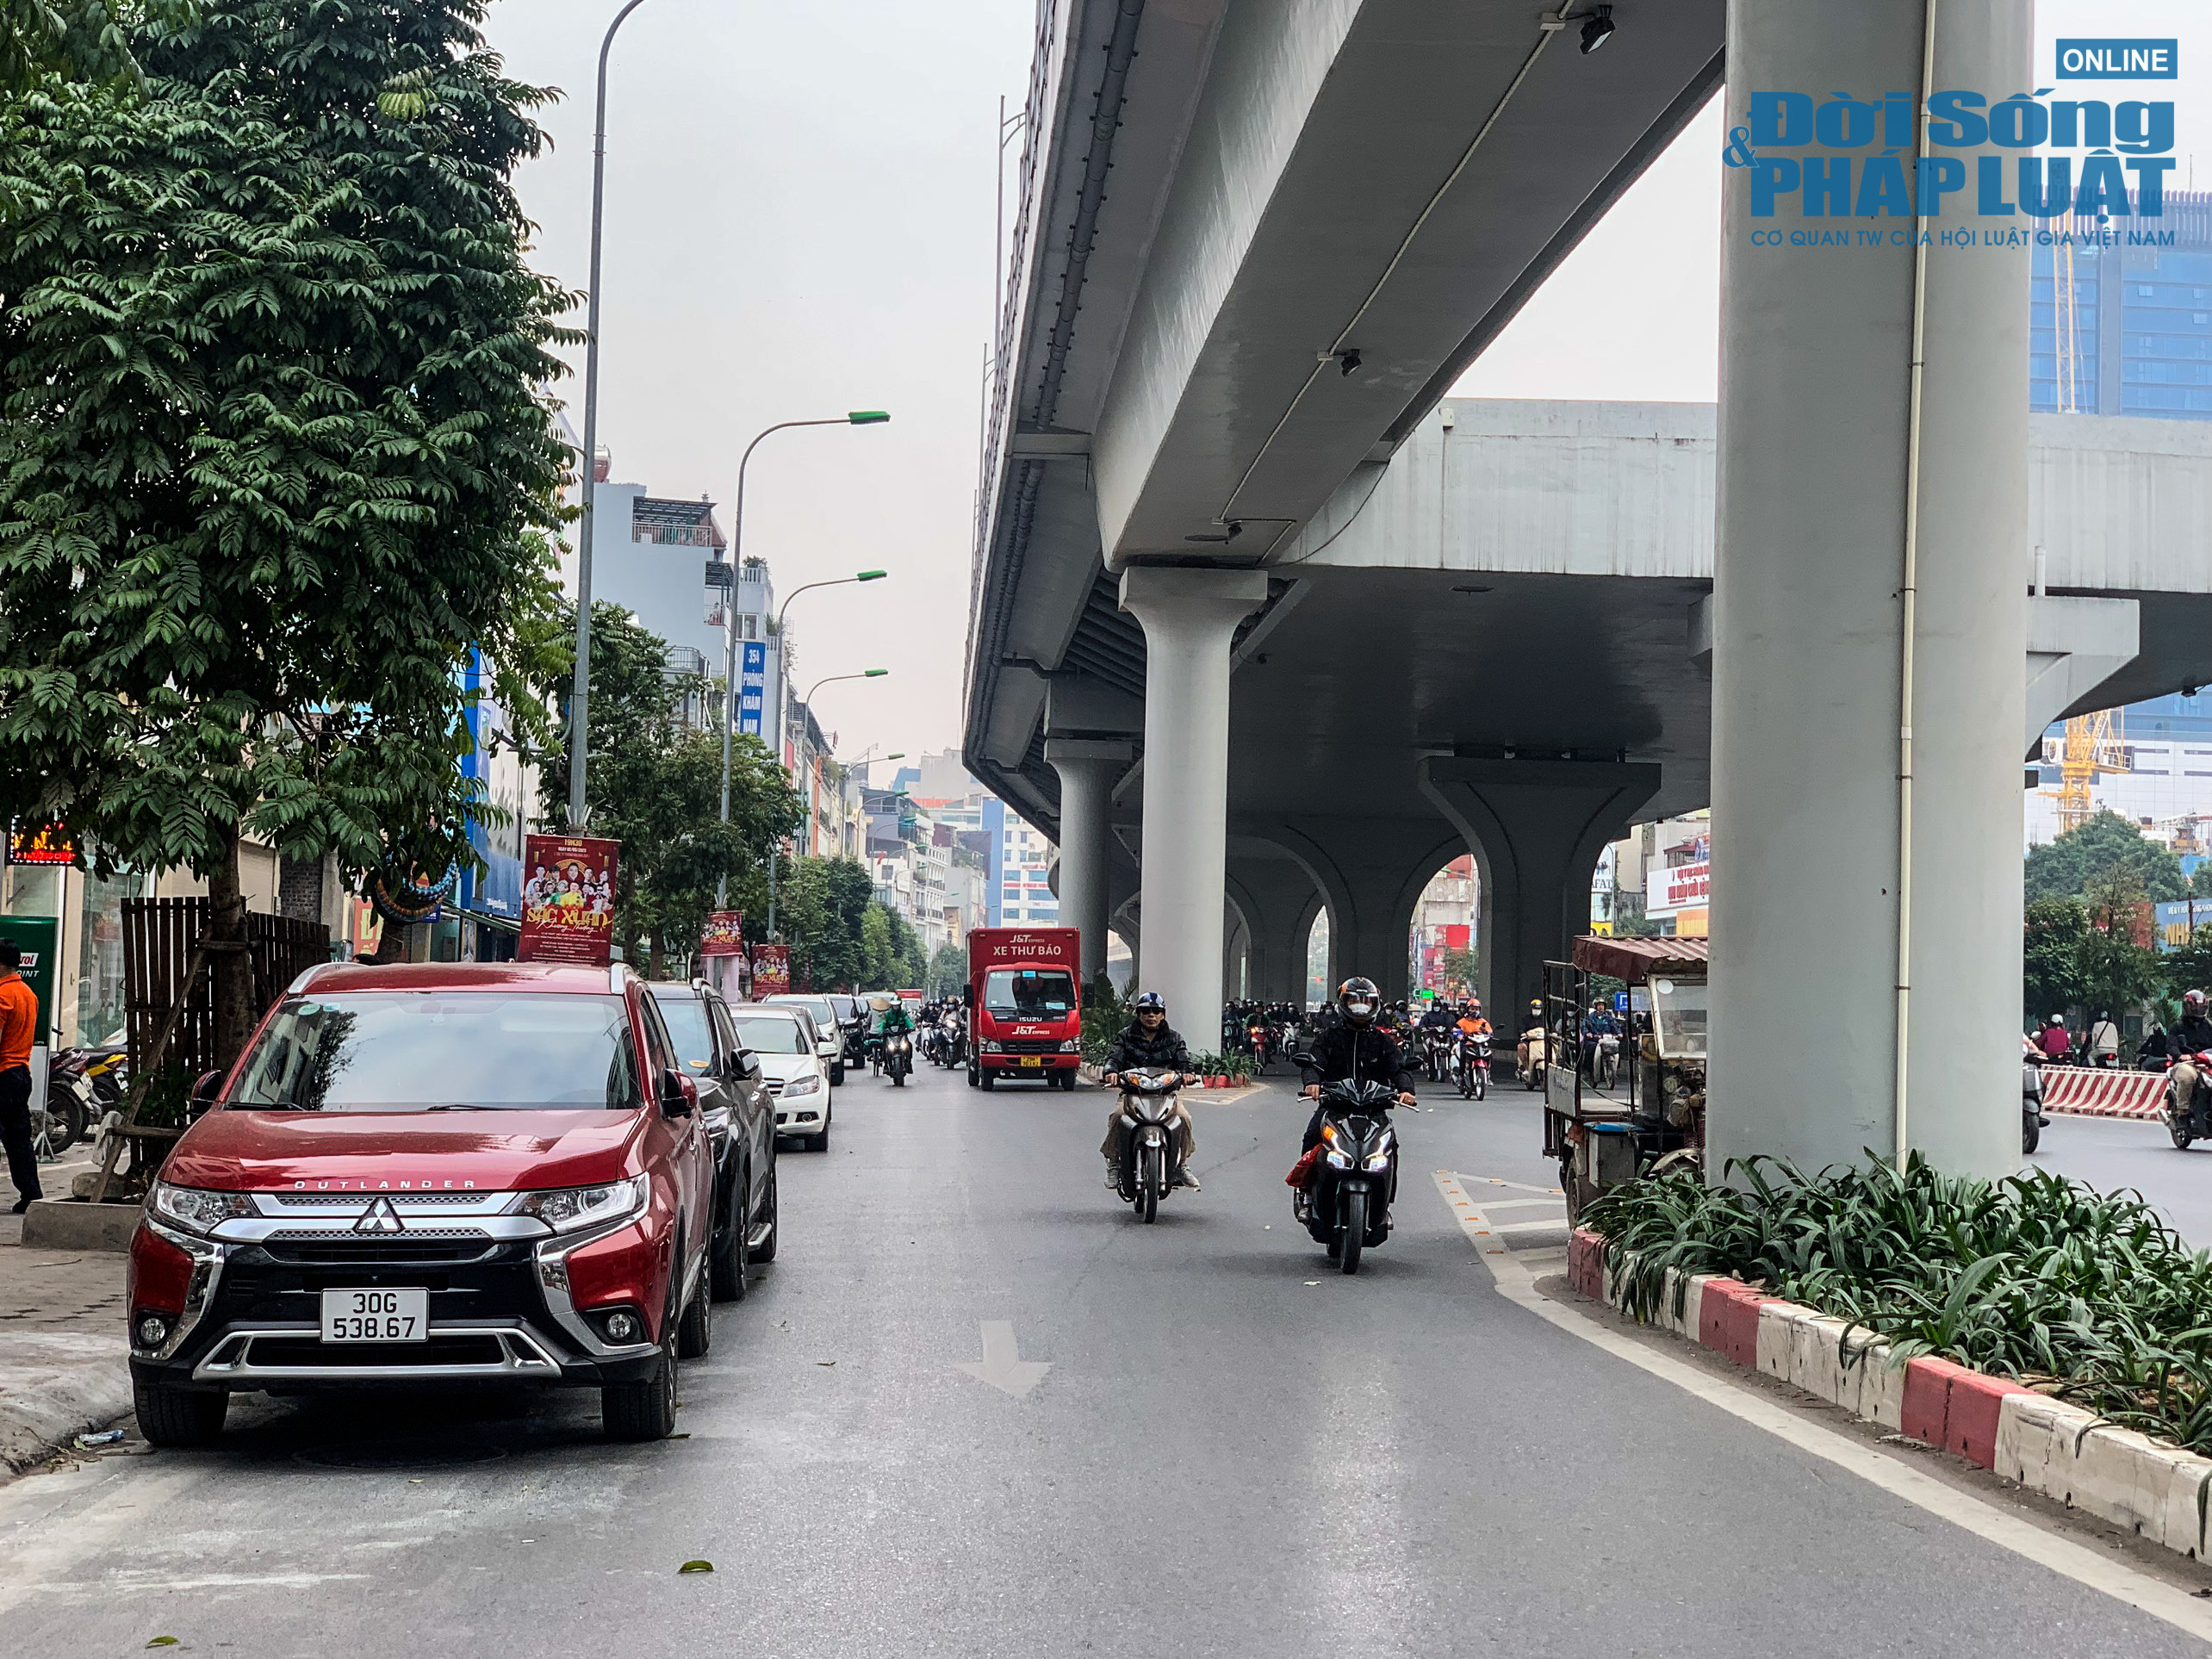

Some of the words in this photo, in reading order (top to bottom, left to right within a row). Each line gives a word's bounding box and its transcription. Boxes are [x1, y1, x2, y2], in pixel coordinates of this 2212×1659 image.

[743, 669, 763, 687] PHÒNG
[743, 693, 761, 711] KHÁM
[1010, 935, 1032, 943] J&T
[993, 946, 1008, 956] XE
[1010, 945, 1036, 955] THƯ
[1038, 944, 1061, 956] BÁO
[1011, 1026, 1036, 1035] J&T
[294, 1180, 475, 1190] OUTLANDER
[352, 1293, 397, 1314] 30G
[332, 1316, 416, 1339] 538.67
